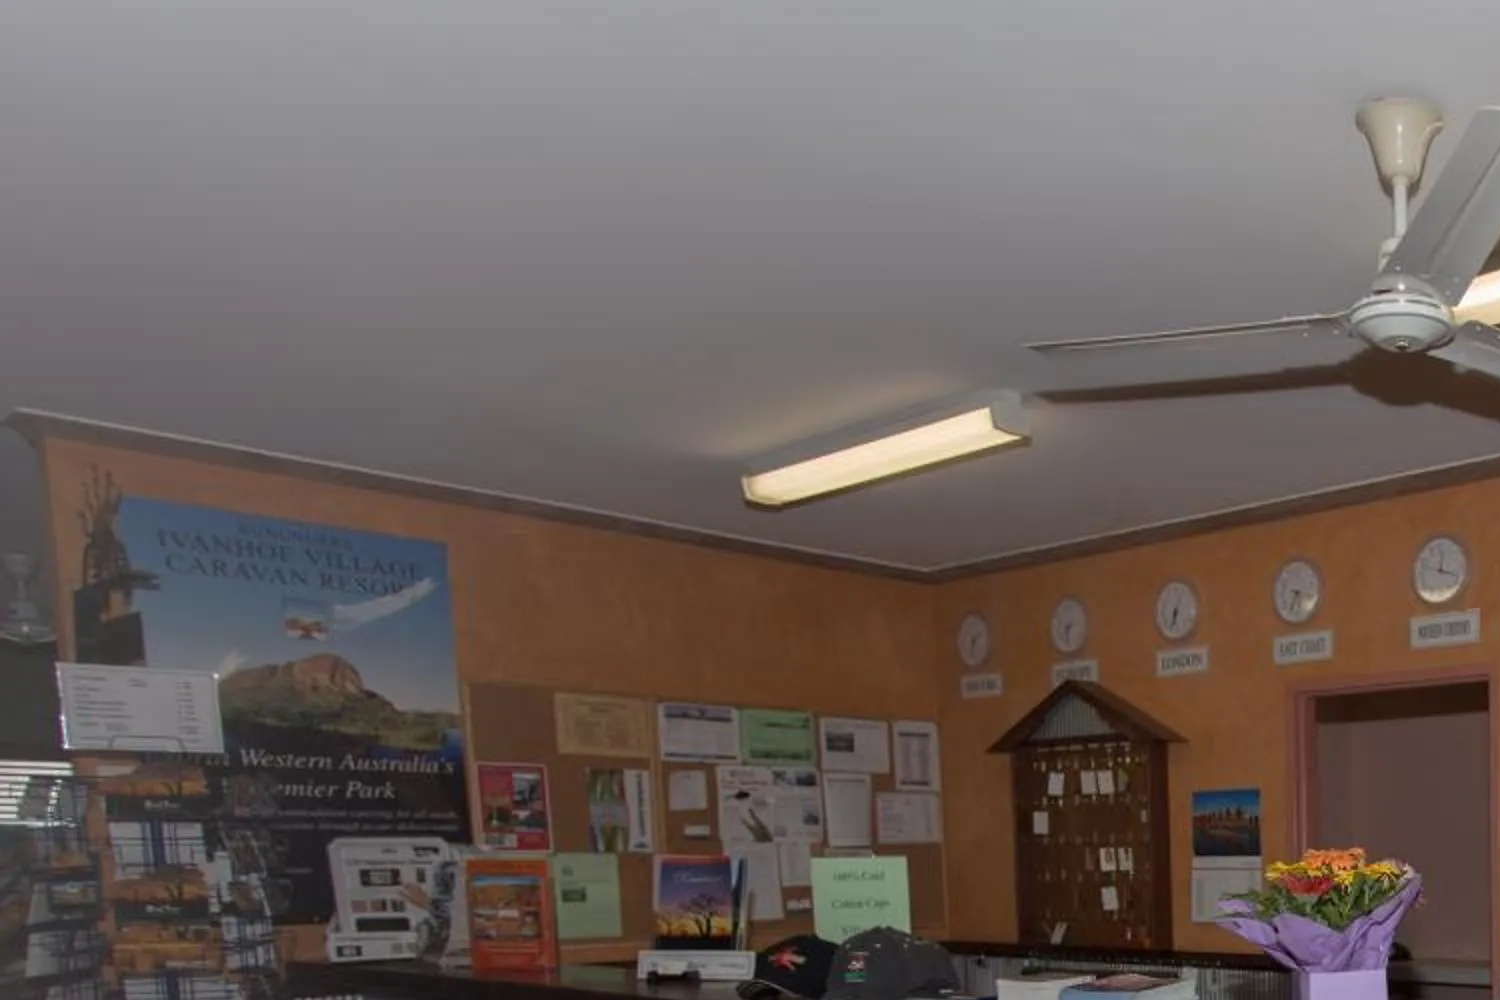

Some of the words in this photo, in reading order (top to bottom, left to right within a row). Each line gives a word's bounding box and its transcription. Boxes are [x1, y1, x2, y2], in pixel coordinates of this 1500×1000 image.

[157, 528, 293, 563] IVANHOE
[305, 548, 422, 580] VILLAGE
[164, 555, 311, 587] CARAVAN
[320, 573, 410, 597] RESOR
[1160, 653, 1204, 672] LONDON
[240, 748, 334, 771] Western
[338, 752, 456, 774] Australia's
[345, 779, 397, 799] Park
